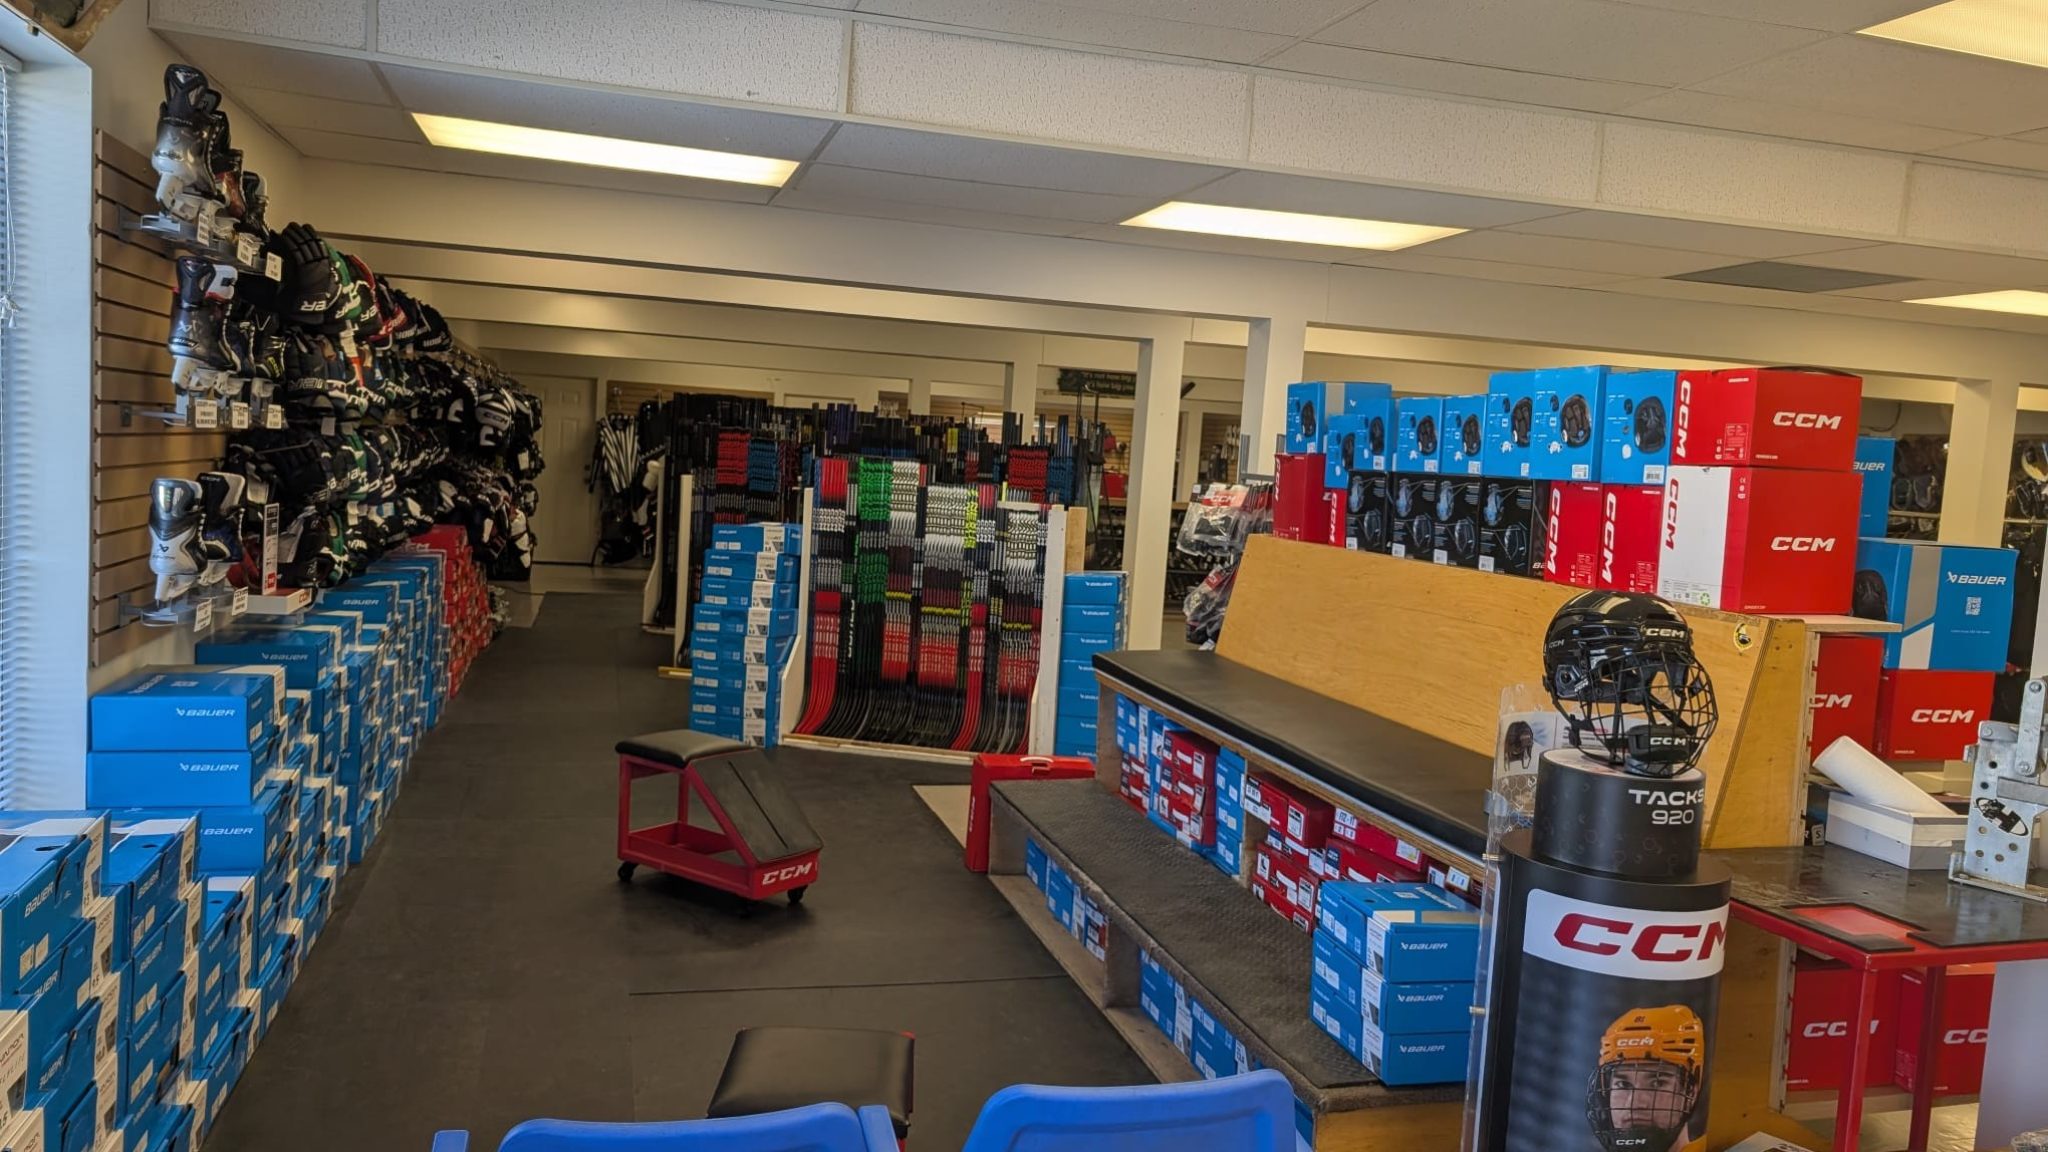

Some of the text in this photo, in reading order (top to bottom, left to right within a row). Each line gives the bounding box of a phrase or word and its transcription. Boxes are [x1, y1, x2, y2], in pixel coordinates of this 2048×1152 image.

[1676, 379, 1691, 458] CCM
[1773, 411, 1842, 430] CCM
[1853, 461, 1886, 472] AUER
[1665, 478, 1679, 550] CCM
[1547, 488, 1561, 574] CCM
[1602, 492, 1617, 584] CCM
[1770, 536, 1836, 552] CCM
[1957, 575, 2007, 586] BAUER
[1809, 694, 1853, 708] CM
[186, 708, 236, 717] BAUER
[1911, 709, 1975, 724] CCM
[1650, 736, 1687, 746] CCM
[190, 763, 240, 772] BAUER
[1652, 809, 1695, 825] 920
[204, 827, 254, 836] BAUER
[762, 862, 812, 885] CCM
[1409, 942, 1449, 950] BAUER
[1405, 994, 1444, 1002] BAUER
[1617, 1037, 1655, 1047] CCM
[1407, 1044, 1446, 1053] BAUER
